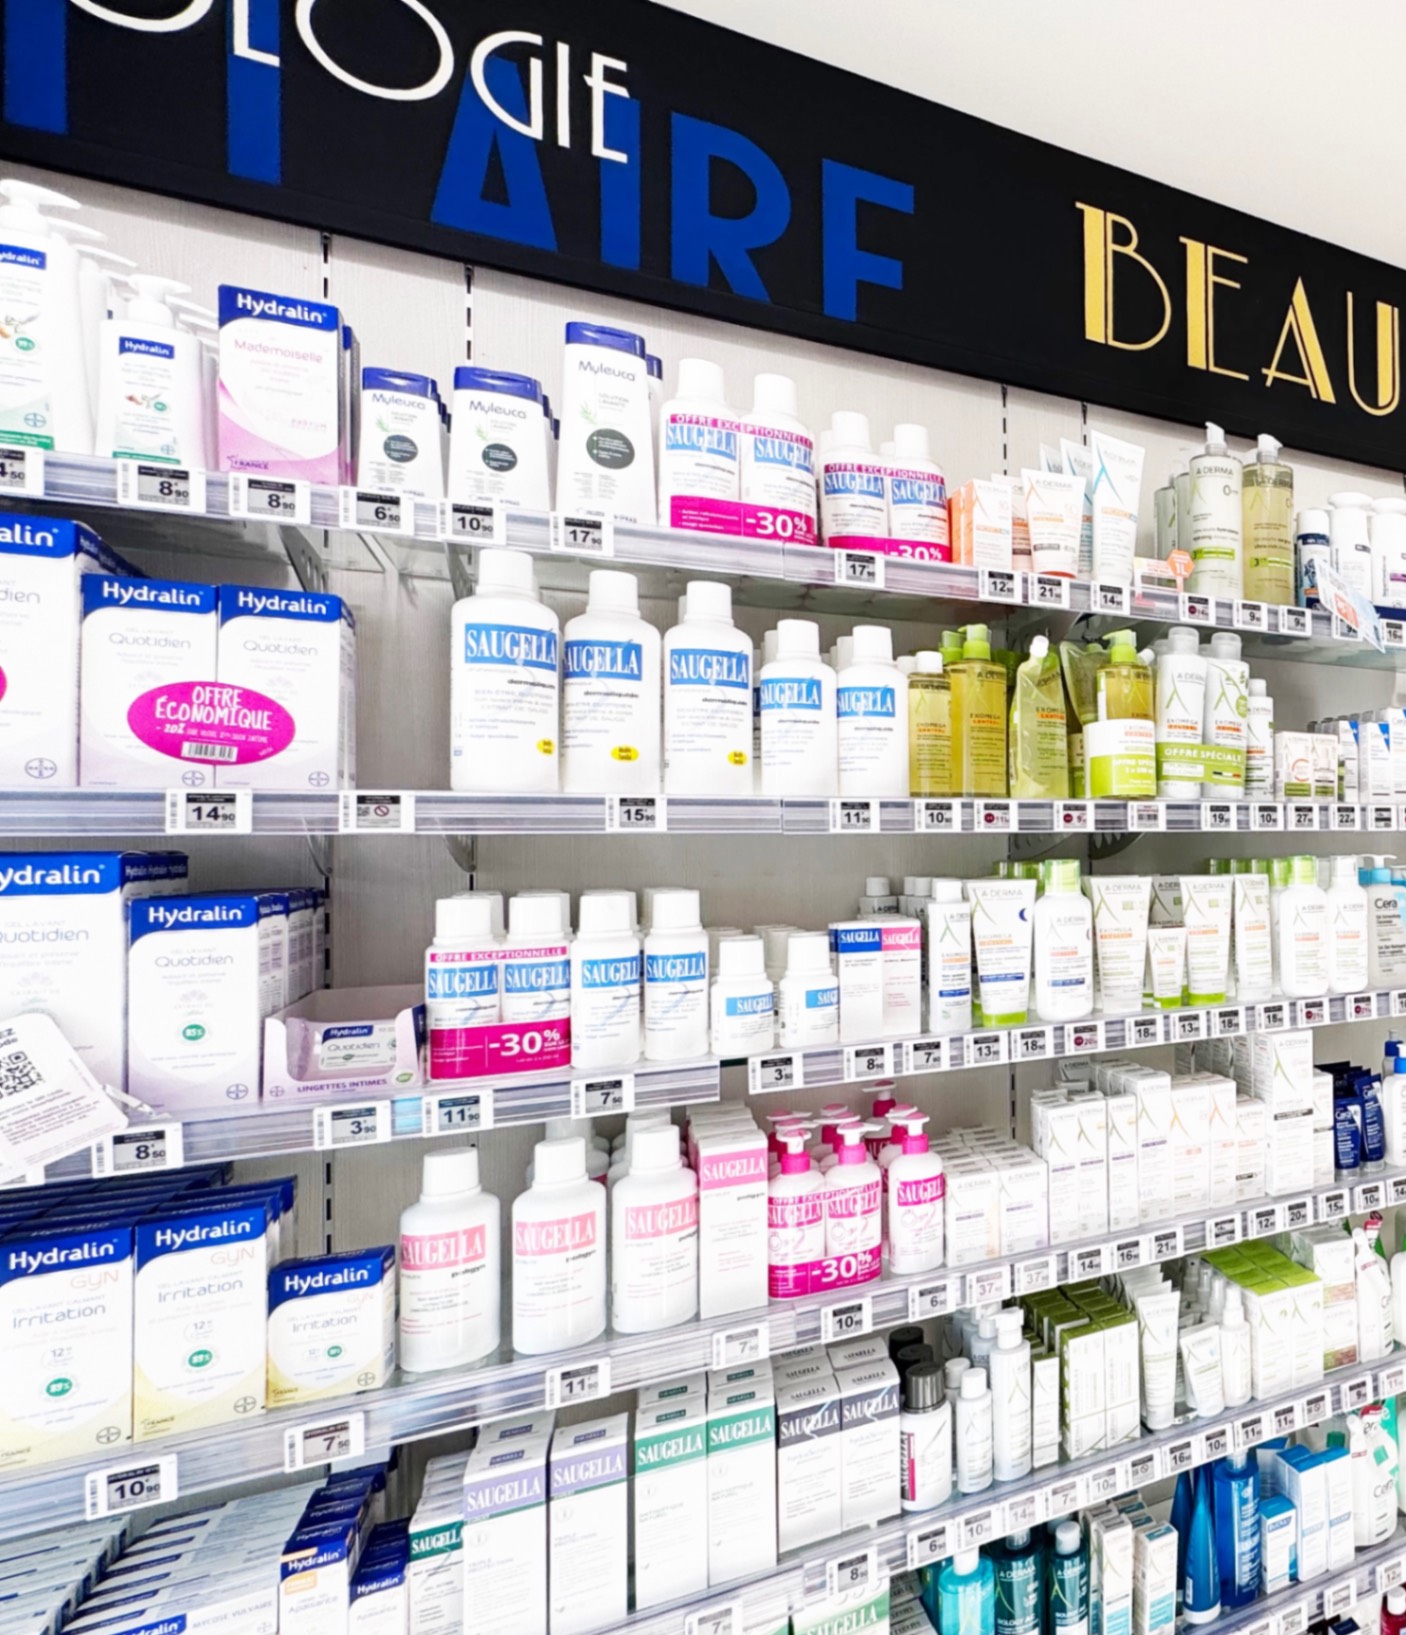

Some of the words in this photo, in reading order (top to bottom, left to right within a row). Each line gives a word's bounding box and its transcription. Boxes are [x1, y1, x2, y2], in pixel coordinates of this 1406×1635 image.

[237, 293, 322, 324] Hydralin
[124, 340, 169, 356] Hydralin
[234, 339, 323, 364] Mademoiselle
[578, 359, 636, 382] Myleuca
[372, 393, 426, 412] Myleuca
[469, 400, 527, 420] Myleuca
[666, 424, 737, 457] SAUGELLA
[103, 582, 200, 607] Hydralin
[239, 591, 327, 615] Hydralin
[109, 632, 191, 649] Quotidien
[243, 640, 318, 657] Quotidien
[468, 629, 557, 665] SAUGELLA
[670, 653, 747, 684] SAUGELLA
[192, 686, 244, 708] OFFRE
[155, 695, 273, 731] ÉCONOMIQUE
[1164, 748, 1199, 759] OFFRE
[1200, 748, 1242, 762] SPÉCIALE
[149, 906, 242, 928] Hydralin
[841, 930, 880, 943] SAUGELLA
[155, 954, 234, 968] Quotidien
[434, 952, 469, 963] OFFRE
[471, 947, 563, 960] EXCEPTIONNELLE
[646, 956, 705, 979] SAUGELLA
[429, 971, 497, 996] SAUGELLA
[330, 1027, 368, 1037] Hydralin
[489, 1028, 561, 1057] -30%
[326, 1042, 381, 1052] Quotidien
[297, 1081, 347, 1093] LINGETTES
[349, 1078, 388, 1090] INTIMES
[703, 1156, 766, 1182] SAUGELLA
[155, 1218, 250, 1249] Hydralin
[516, 1220, 594, 1253] SAUGELLA
[10, 1241, 114, 1272] Hydralin
[210, 1245, 255, 1268] GYN
[70, 1269, 119, 1291] GYN
[158, 1278, 243, 1303] Irritation
[284, 1266, 369, 1293] Hydralin
[12, 1302, 106, 1330] Irritation
[292, 1313, 357, 1335] Irritation
[843, 1392, 899, 1424] SAUGELLA
[710, 1414, 772, 1446] SAUGELLA
[780, 1404, 840, 1439] SAUGELLA
[638, 1434, 703, 1466] SAUGELLA
[553, 1450, 624, 1488] SAUGELLA
[466, 1475, 542, 1511] SAUGELLA
[288, 1549, 339, 1570] Hydralin
[357, 1575, 400, 1594] Hydralin
